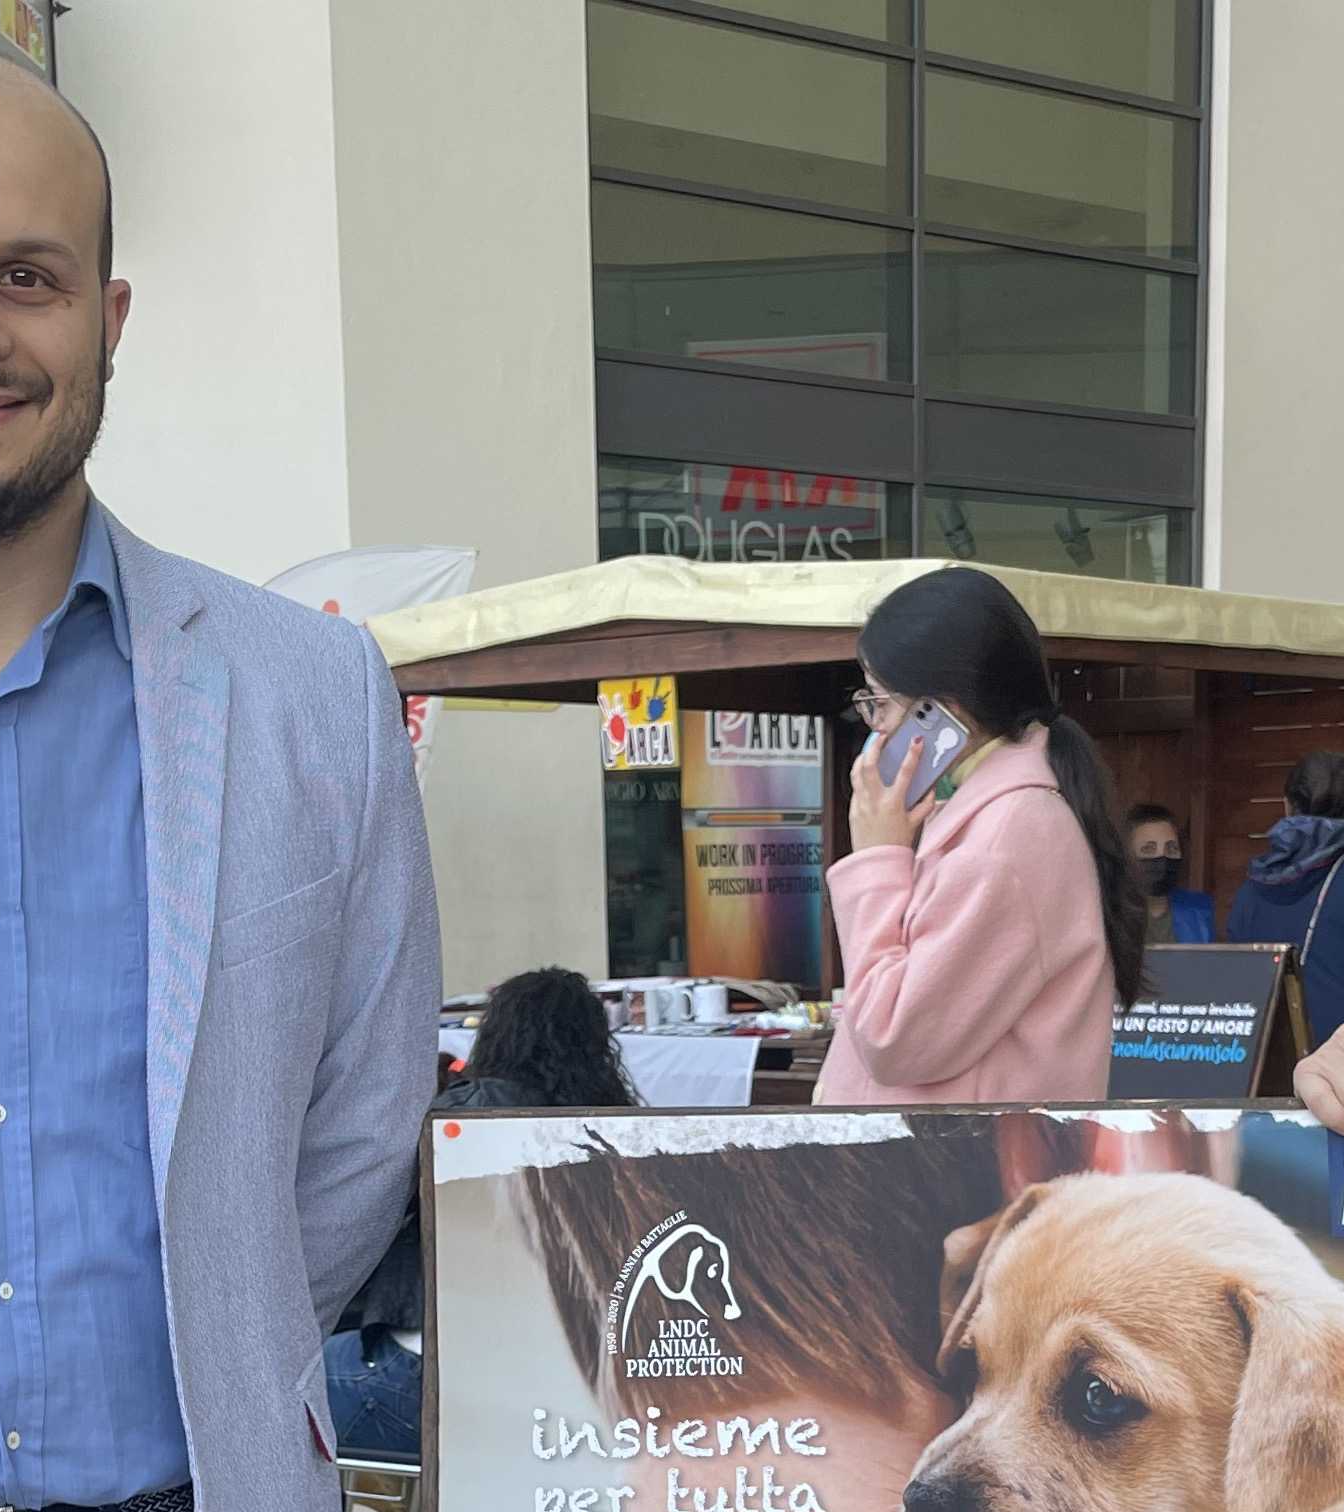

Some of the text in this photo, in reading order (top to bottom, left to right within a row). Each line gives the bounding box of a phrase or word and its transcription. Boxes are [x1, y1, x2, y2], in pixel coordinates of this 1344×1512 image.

[695, 844, 739, 868] WORK
[742, 844, 756, 867] IN
[707, 876, 821, 896] PROSSIMA APERTURA
[1124, 1017, 1145, 1032] UN
[1147, 1017, 1190, 1034] GESTO
[1190, 1019, 1254, 1036] D'AMORE
[1112, 1035, 1247, 1064] nonlasciarmisolo
[640, 1209, 688, 1249] BATTAGLIE
[618, 1256, 638, 1283] ANNI
[613, 1280, 625, 1295] 70
[607, 1299, 619, 1325] 2020
[658, 1319, 709, 1338] LNDC
[606, 1331, 618, 1355] 1950
[647, 1338, 721, 1357] ANIMAL
[626, 1356, 743, 1377] PROTECTION
[532, 1406, 827, 1459] insieme
